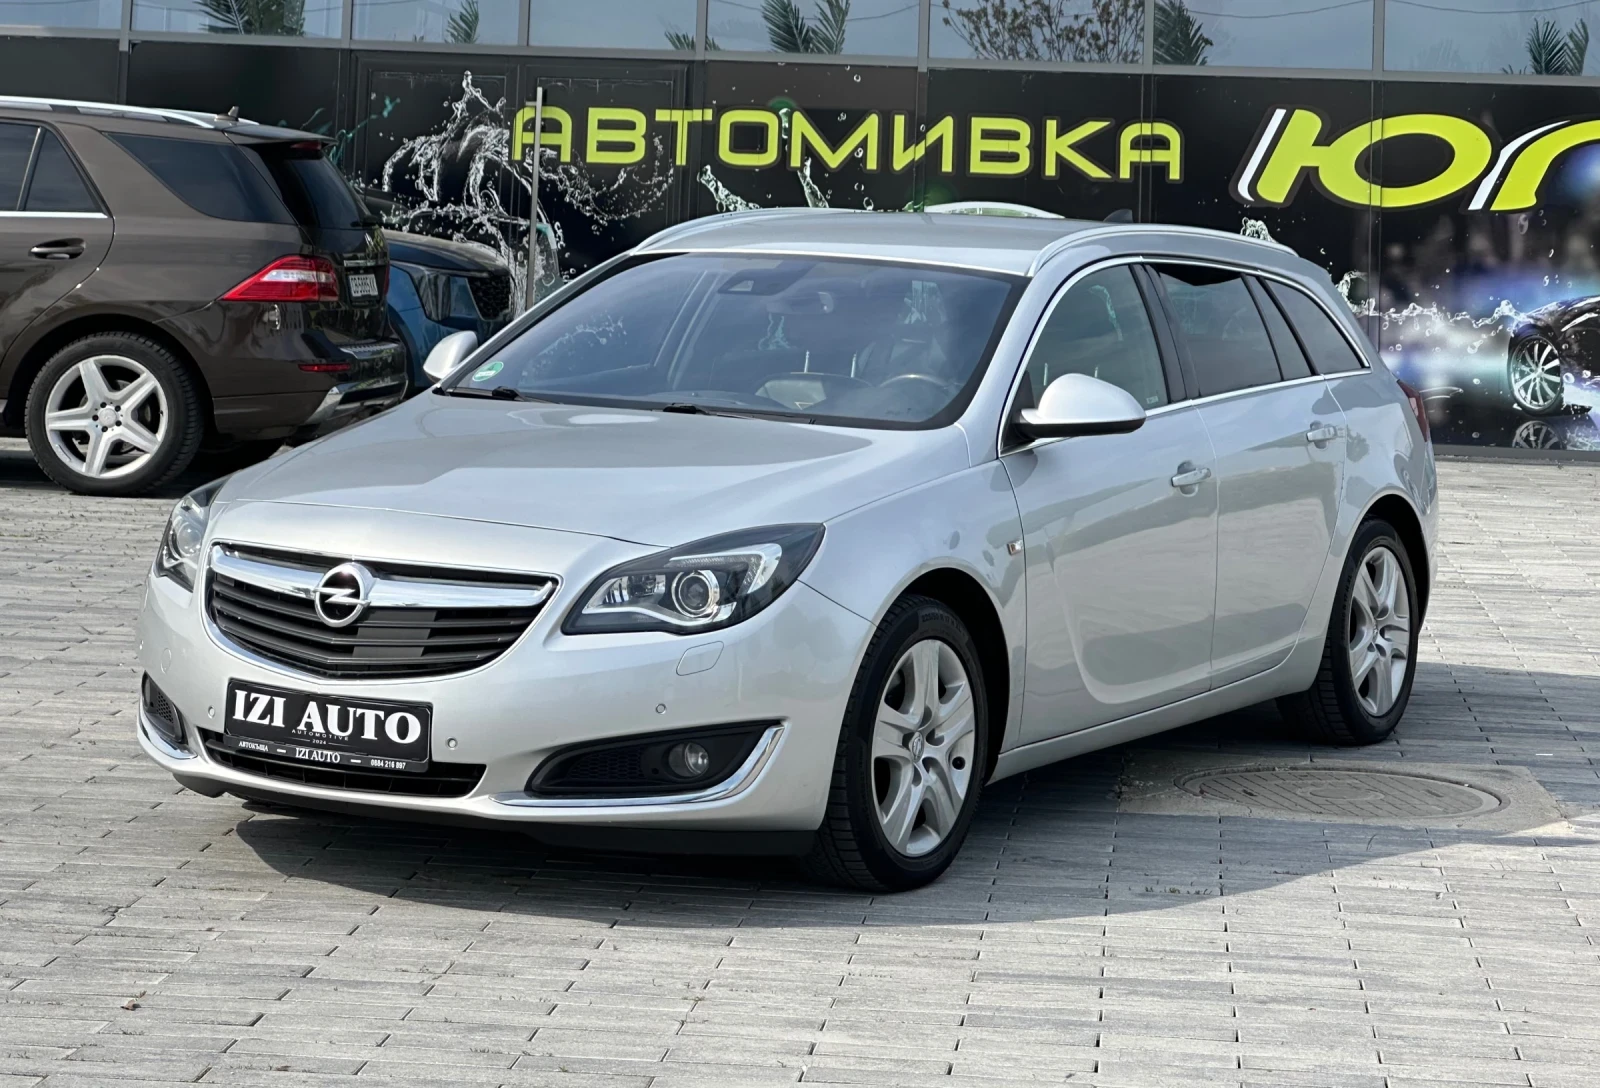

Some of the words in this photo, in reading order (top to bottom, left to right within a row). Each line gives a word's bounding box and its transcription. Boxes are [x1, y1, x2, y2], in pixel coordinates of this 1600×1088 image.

[512, 106, 1181, 180] АВТОМИВКА
[232, 689, 287, 728] IZI
[297, 700, 422, 744] AUTO
[291, 729, 349, 741] AUTOMOTIVE
[295, 747, 310, 760] IZI
[310, 750, 341, 763] AUTO
